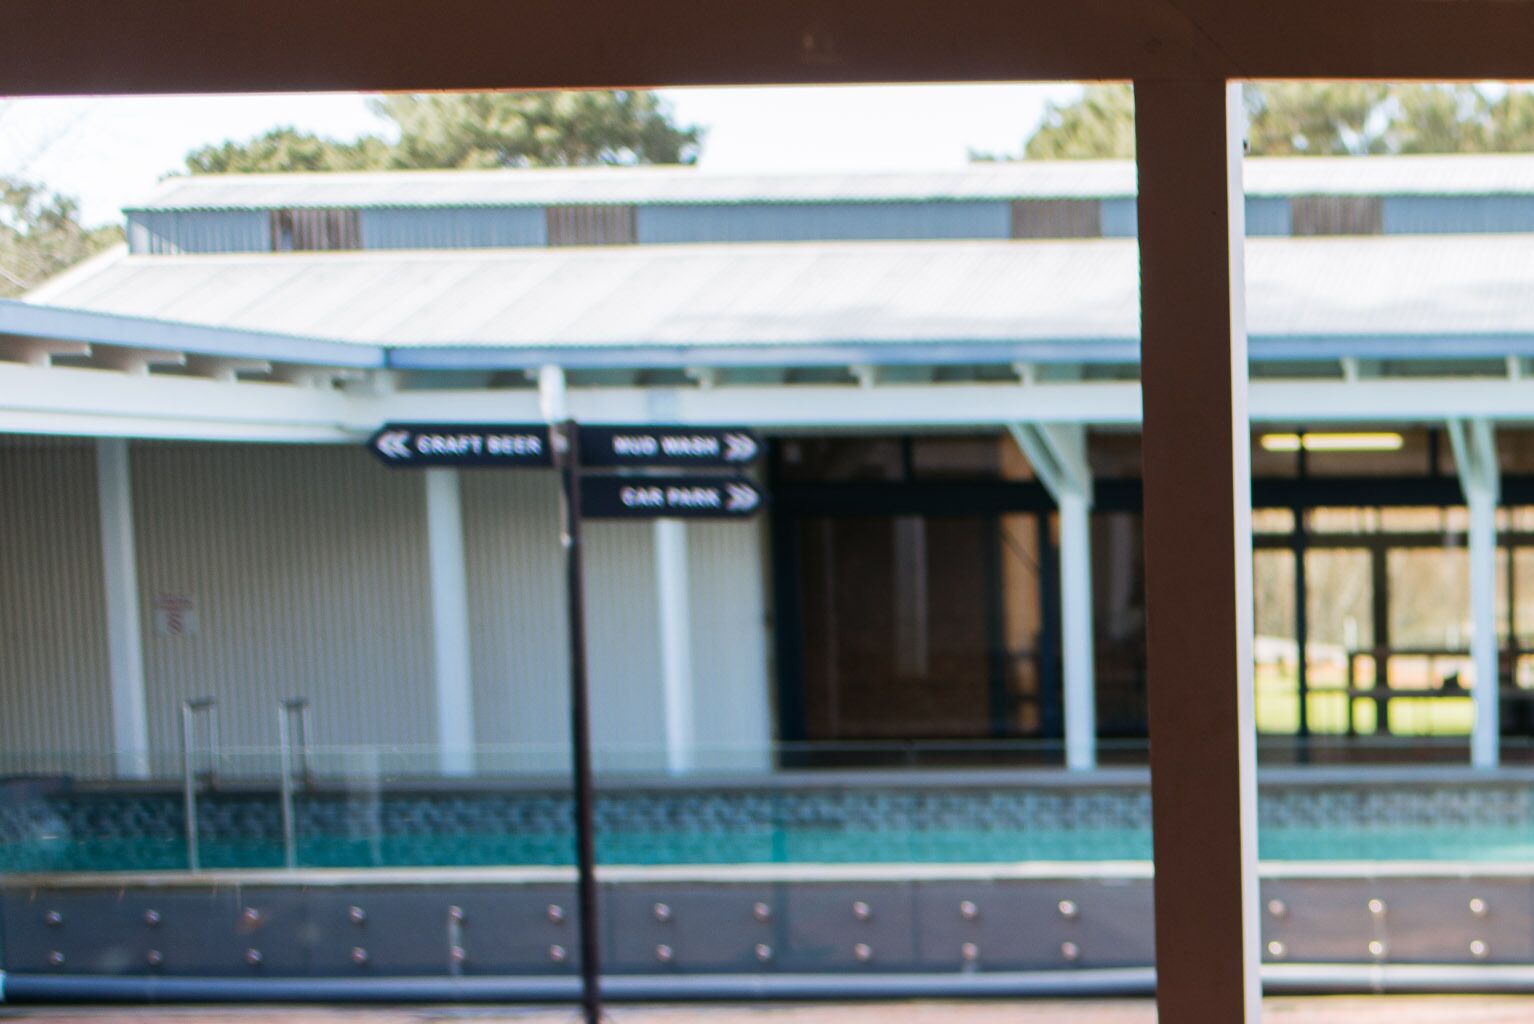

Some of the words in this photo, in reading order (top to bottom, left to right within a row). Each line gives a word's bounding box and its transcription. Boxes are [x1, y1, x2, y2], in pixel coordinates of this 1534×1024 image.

[417, 434, 481, 455] CRAFT
[487, 434, 541, 455] BEER
[661, 434, 718, 455] WASH
[621, 486, 664, 506] CAR
[666, 486, 720, 506] PARK
